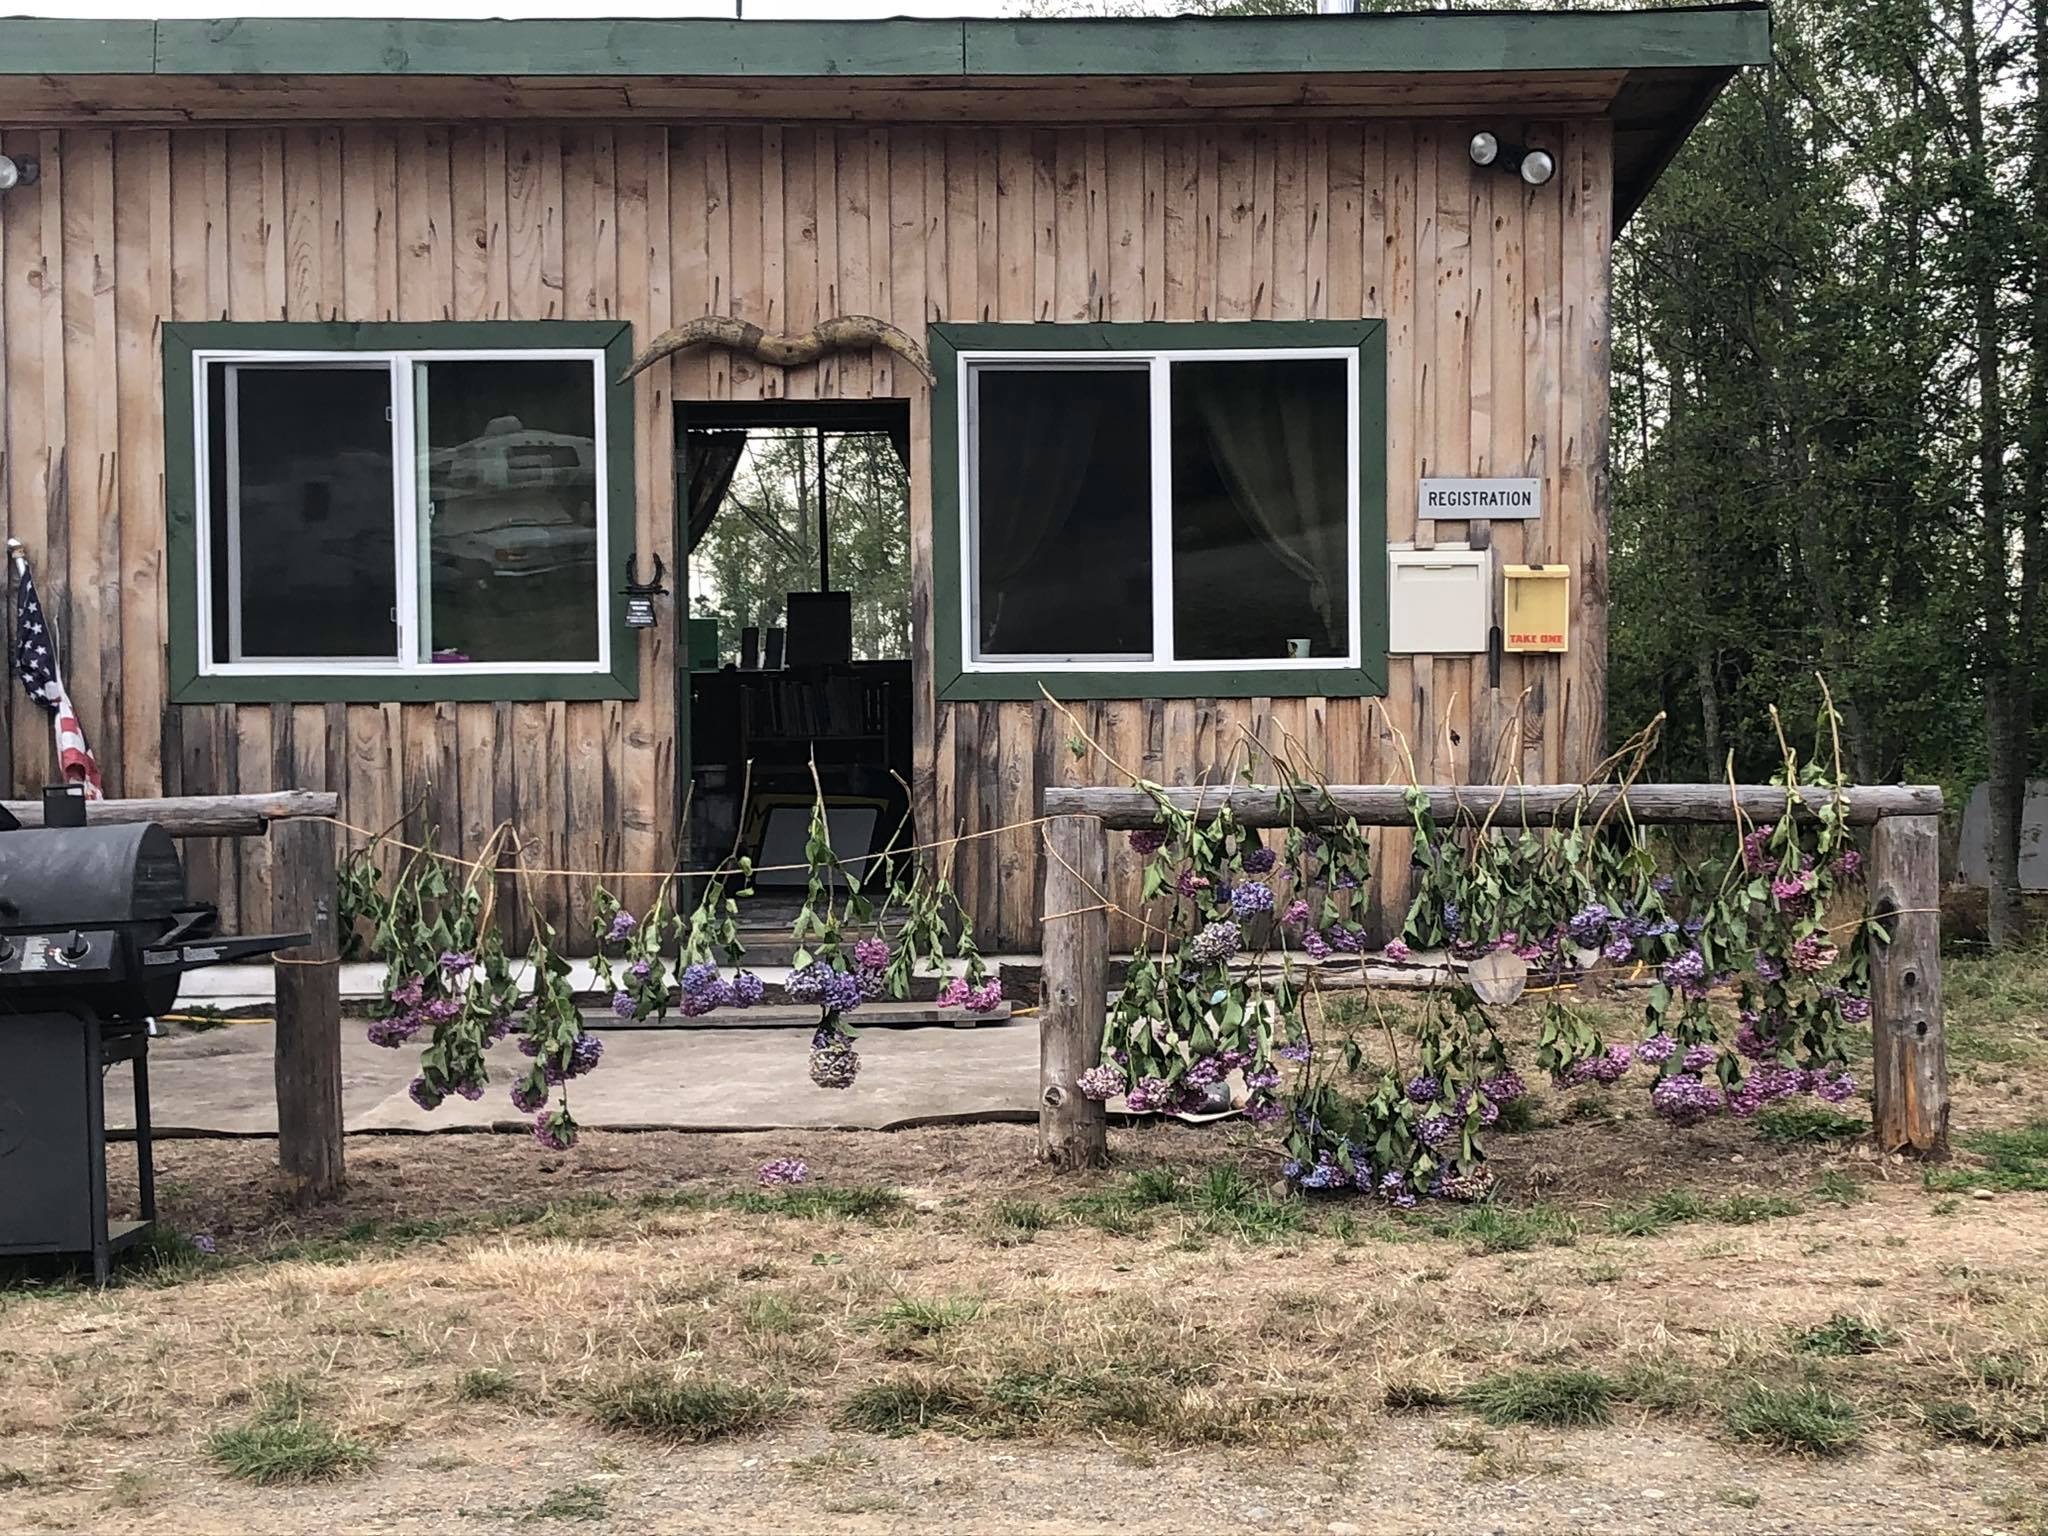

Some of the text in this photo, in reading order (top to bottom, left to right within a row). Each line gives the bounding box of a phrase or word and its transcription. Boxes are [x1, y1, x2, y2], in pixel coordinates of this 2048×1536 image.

[1428, 491, 1531, 506] REGISTRATION
[1510, 634, 1563, 643] TAKE ONE
